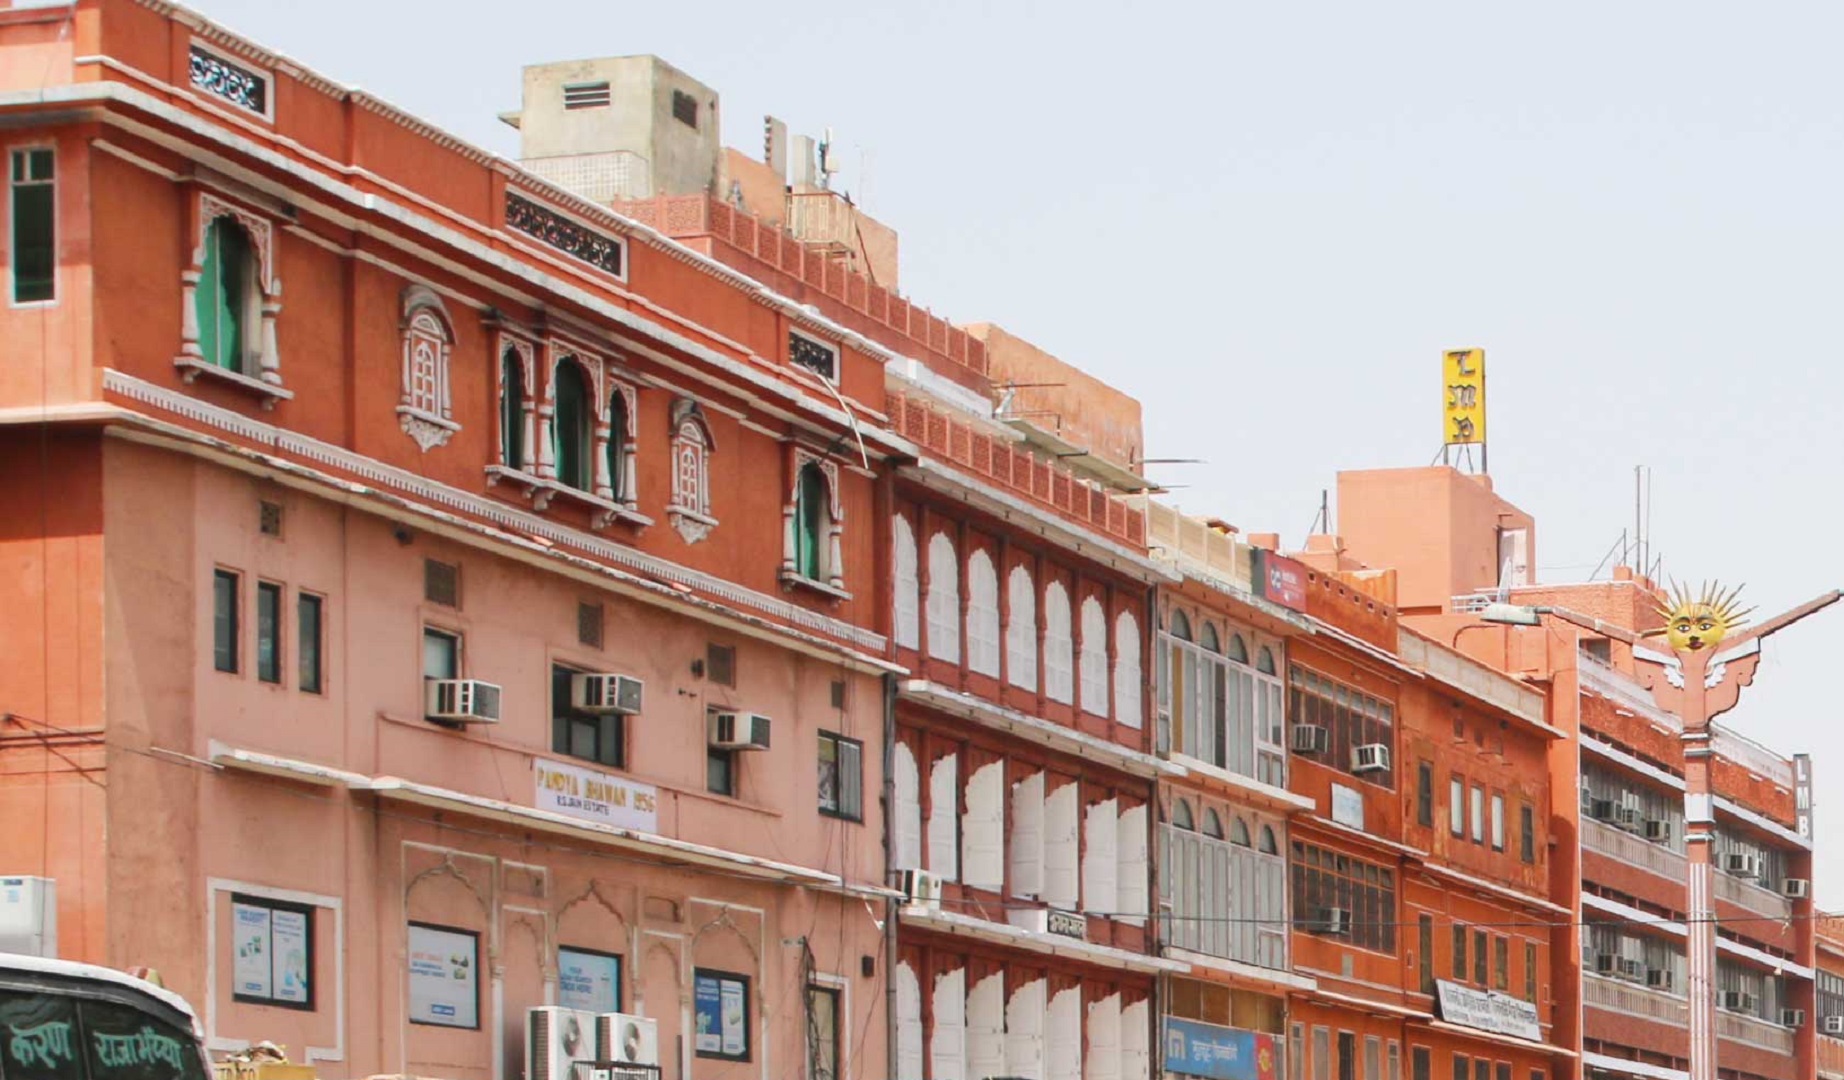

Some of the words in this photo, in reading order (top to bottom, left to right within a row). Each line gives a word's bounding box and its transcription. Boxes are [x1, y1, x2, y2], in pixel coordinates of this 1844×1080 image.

[537, 766, 579, 796] PANDYA
[584, 777, 627, 808] BHAWAN
[583, 799, 610, 816] ESTATE
[1797, 758, 1810, 837] LMB
